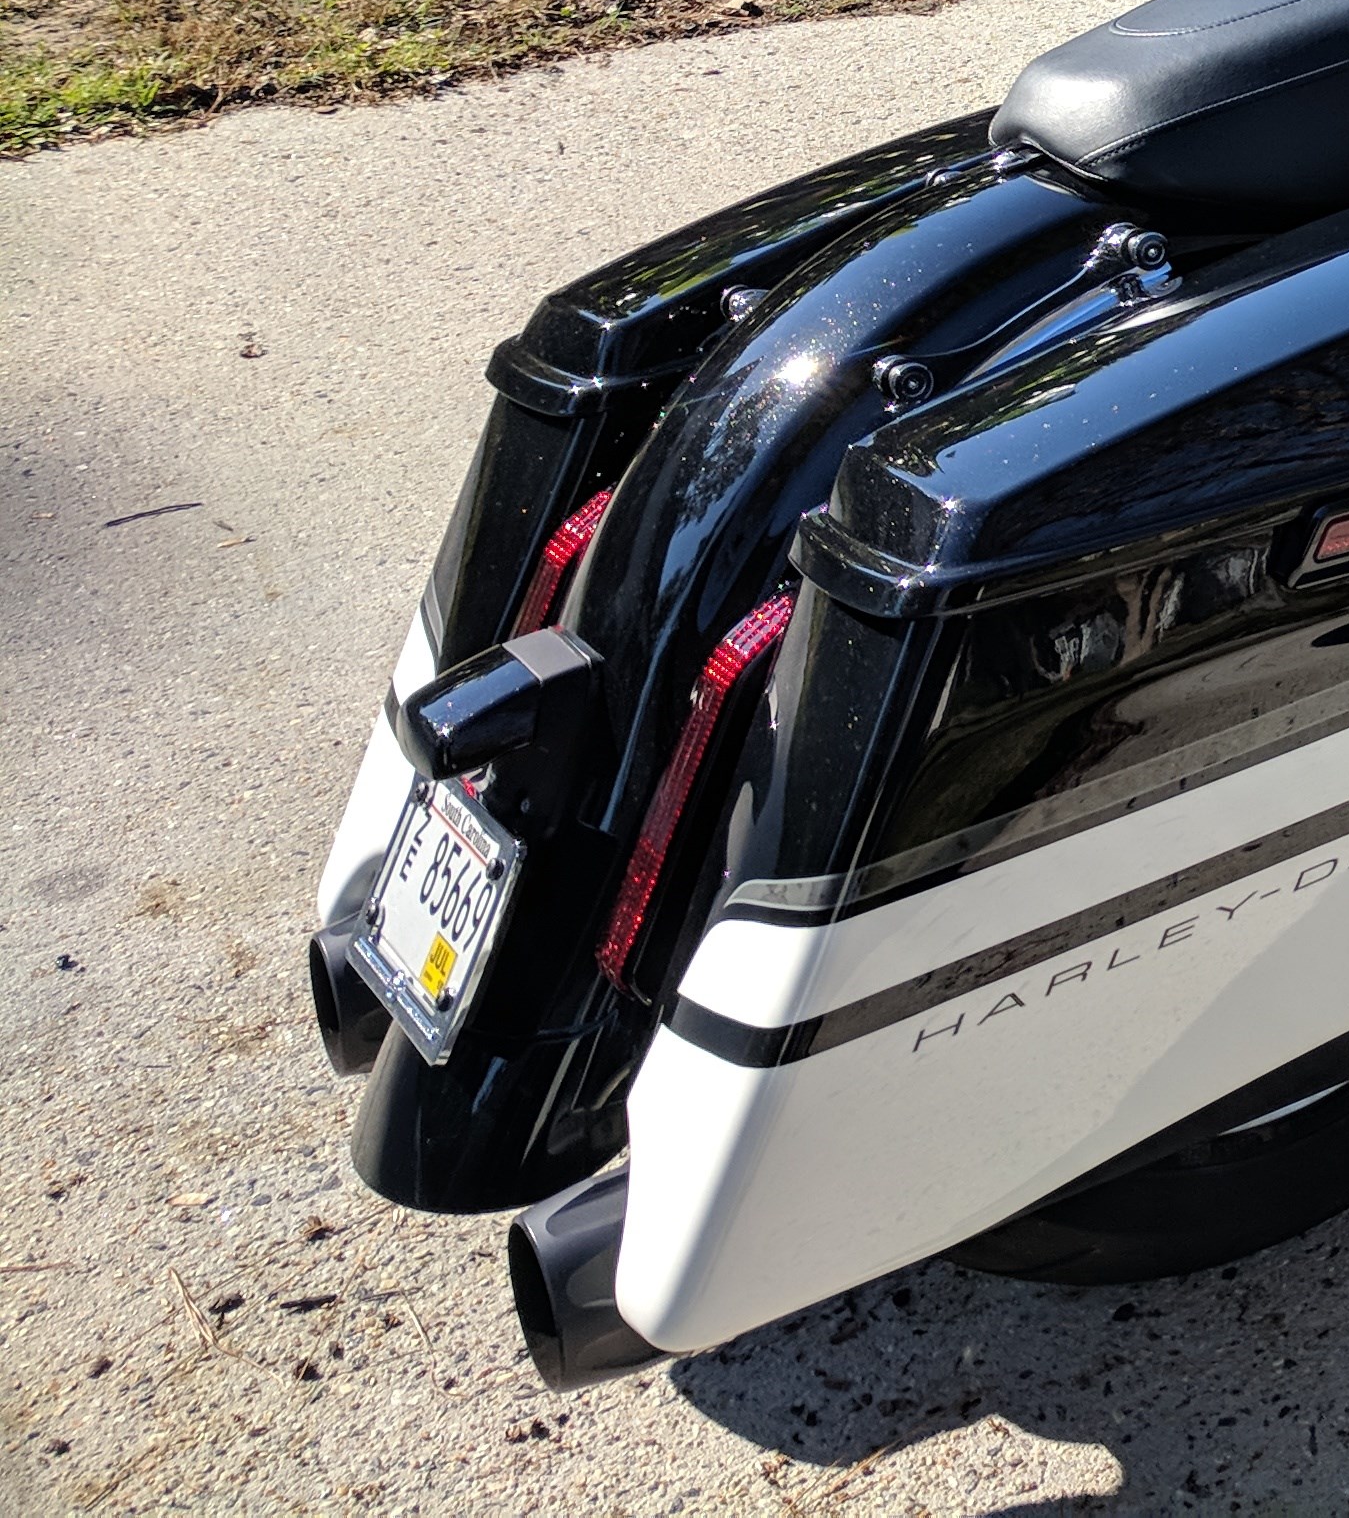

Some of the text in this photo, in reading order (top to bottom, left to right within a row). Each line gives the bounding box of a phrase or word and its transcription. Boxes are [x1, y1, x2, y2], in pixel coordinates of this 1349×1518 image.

[441, 794, 491, 859] South Carolina
[420, 832, 493, 952] 85669
[429, 942, 451, 976] JUL
